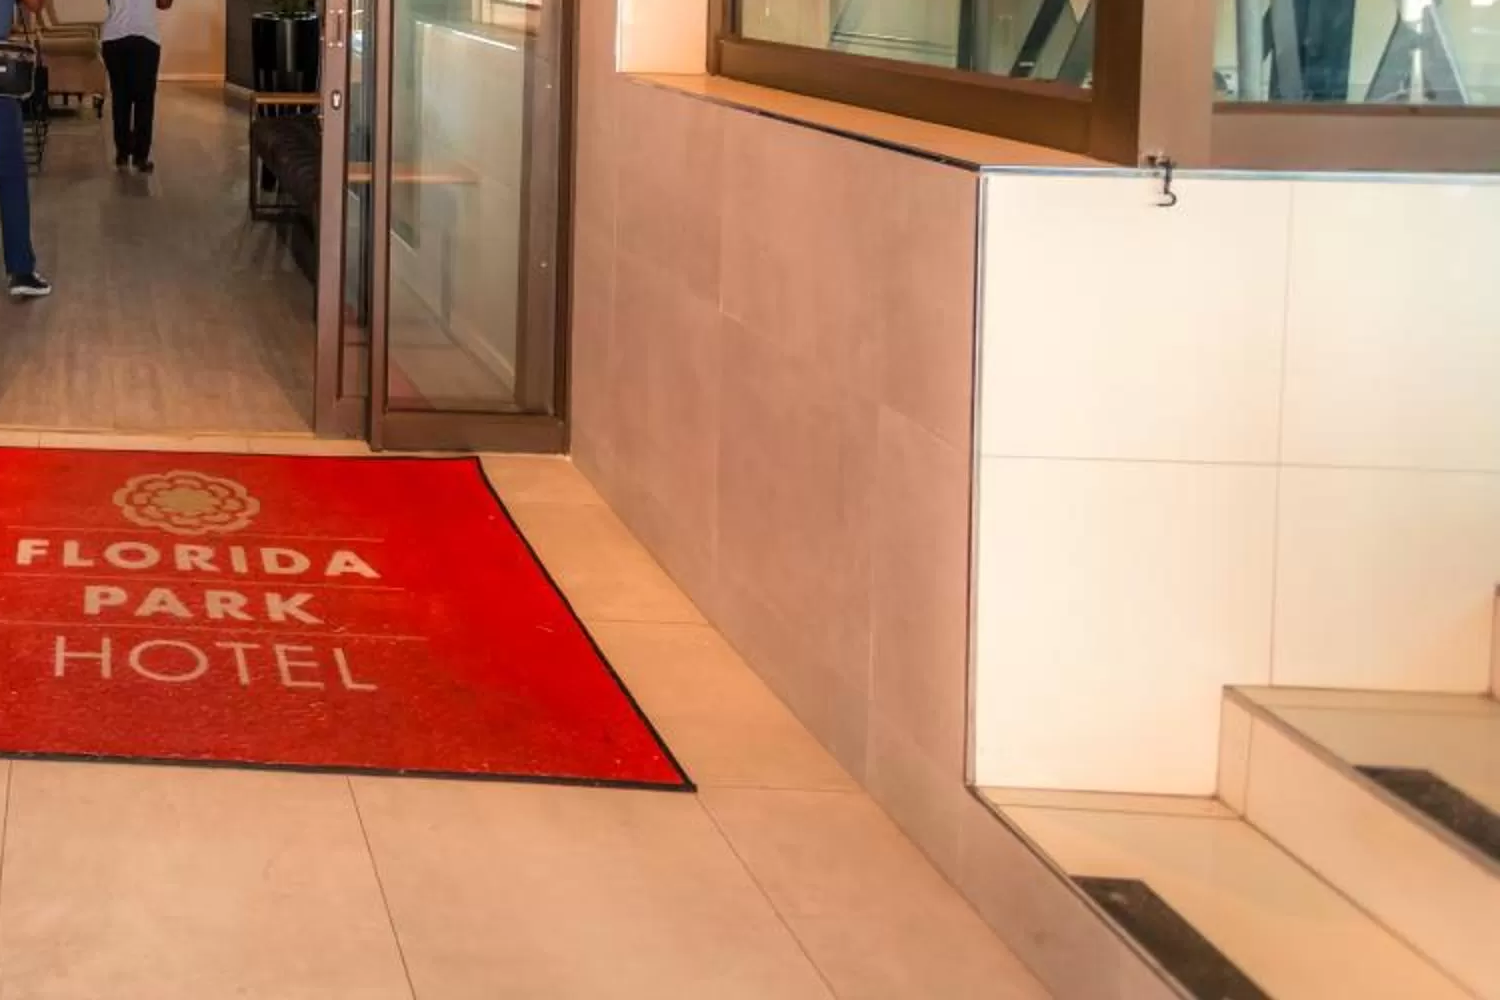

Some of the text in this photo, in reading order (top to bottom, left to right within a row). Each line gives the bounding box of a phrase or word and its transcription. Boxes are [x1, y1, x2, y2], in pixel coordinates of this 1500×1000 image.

[16, 538, 382, 579] FLORIDA
[82, 584, 326, 625] PARK
[52, 634, 379, 692] HOTEL
